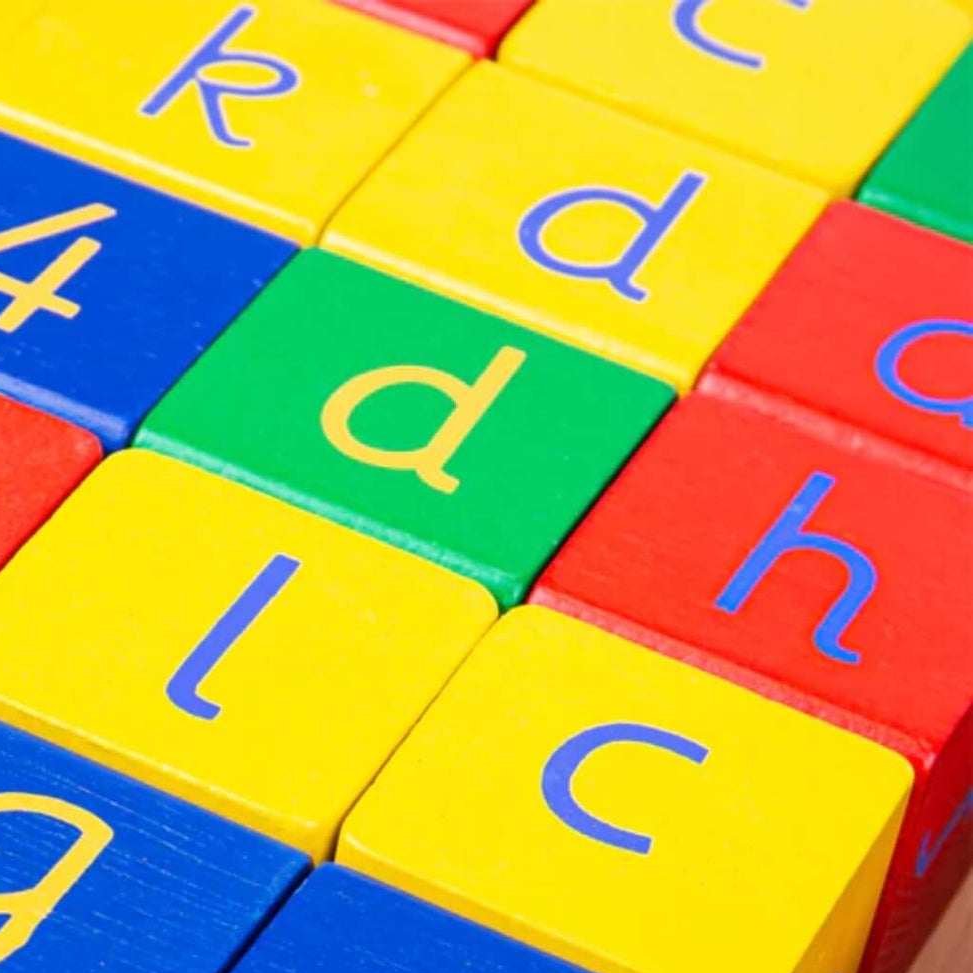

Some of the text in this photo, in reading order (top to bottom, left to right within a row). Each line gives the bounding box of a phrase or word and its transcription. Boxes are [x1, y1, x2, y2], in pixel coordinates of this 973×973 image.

[141, 6, 299, 147] k
[517, 172, 705, 302] d
[321, 346, 526, 494] d
[166, 554, 300, 720] l
[715, 472, 877, 664] h
[541, 723, 708, 854] c
